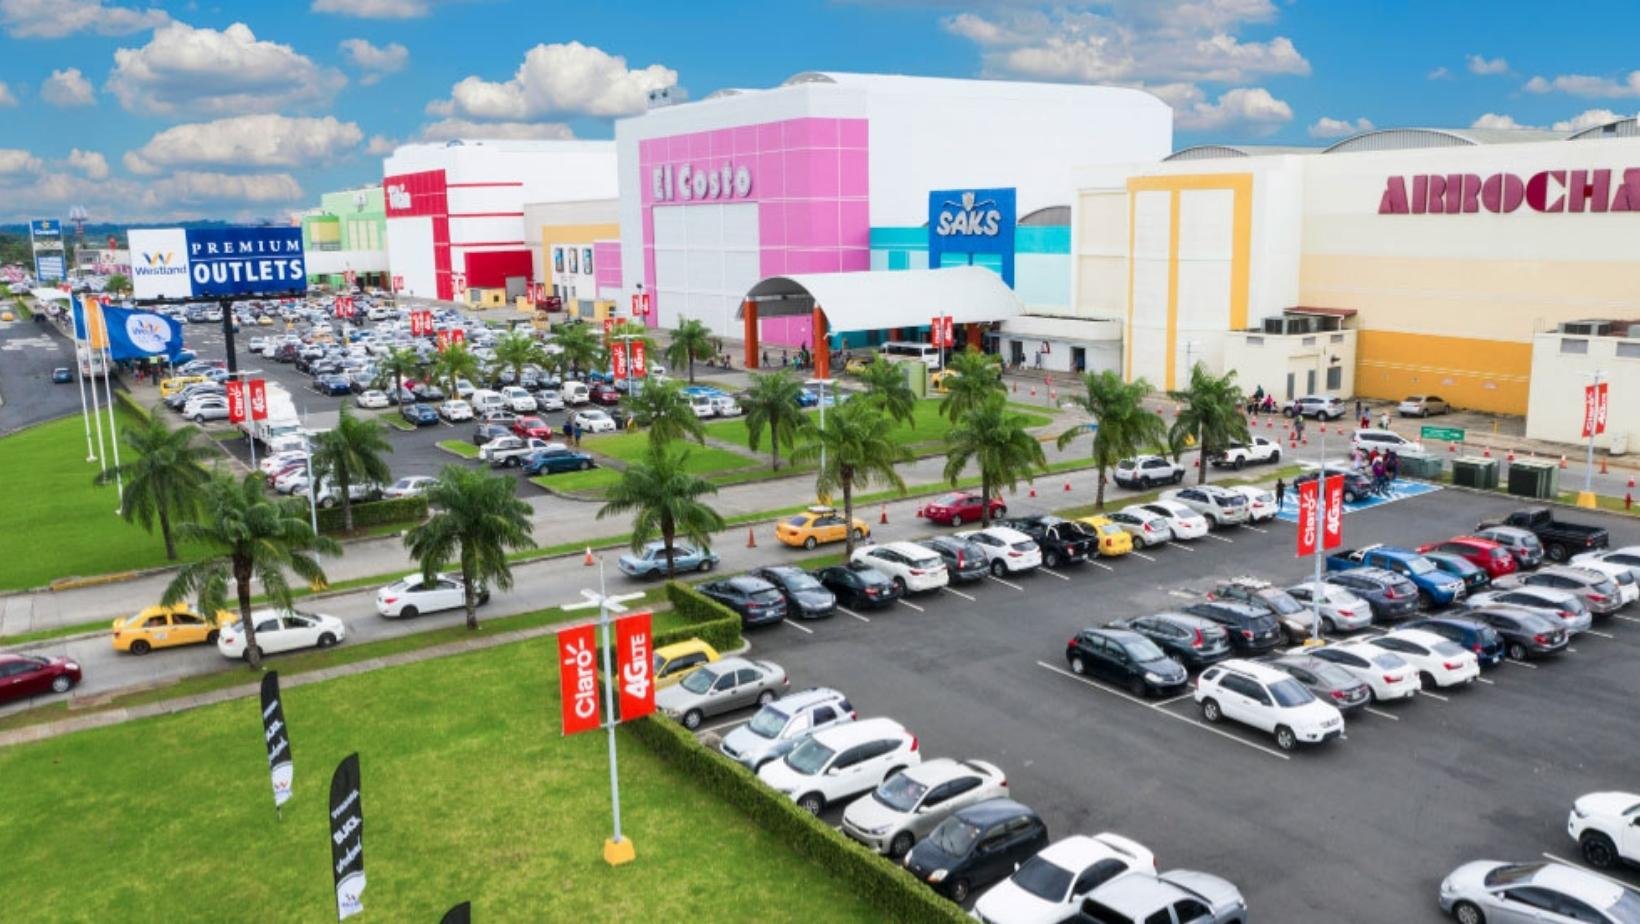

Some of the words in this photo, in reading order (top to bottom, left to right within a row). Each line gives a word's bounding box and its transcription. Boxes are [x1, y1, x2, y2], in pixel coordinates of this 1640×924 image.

[678, 160, 752, 200] Costo
[1378, 167, 1640, 214] ARROCHA
[937, 210, 1001, 236] SAKS
[191, 240, 300, 256] PREMIUM
[135, 264, 187, 276] Westland
[193, 259, 304, 285] OUTLETS
[1303, 493, 1316, 546] Claro
[570, 644, 596, 718] Claro
